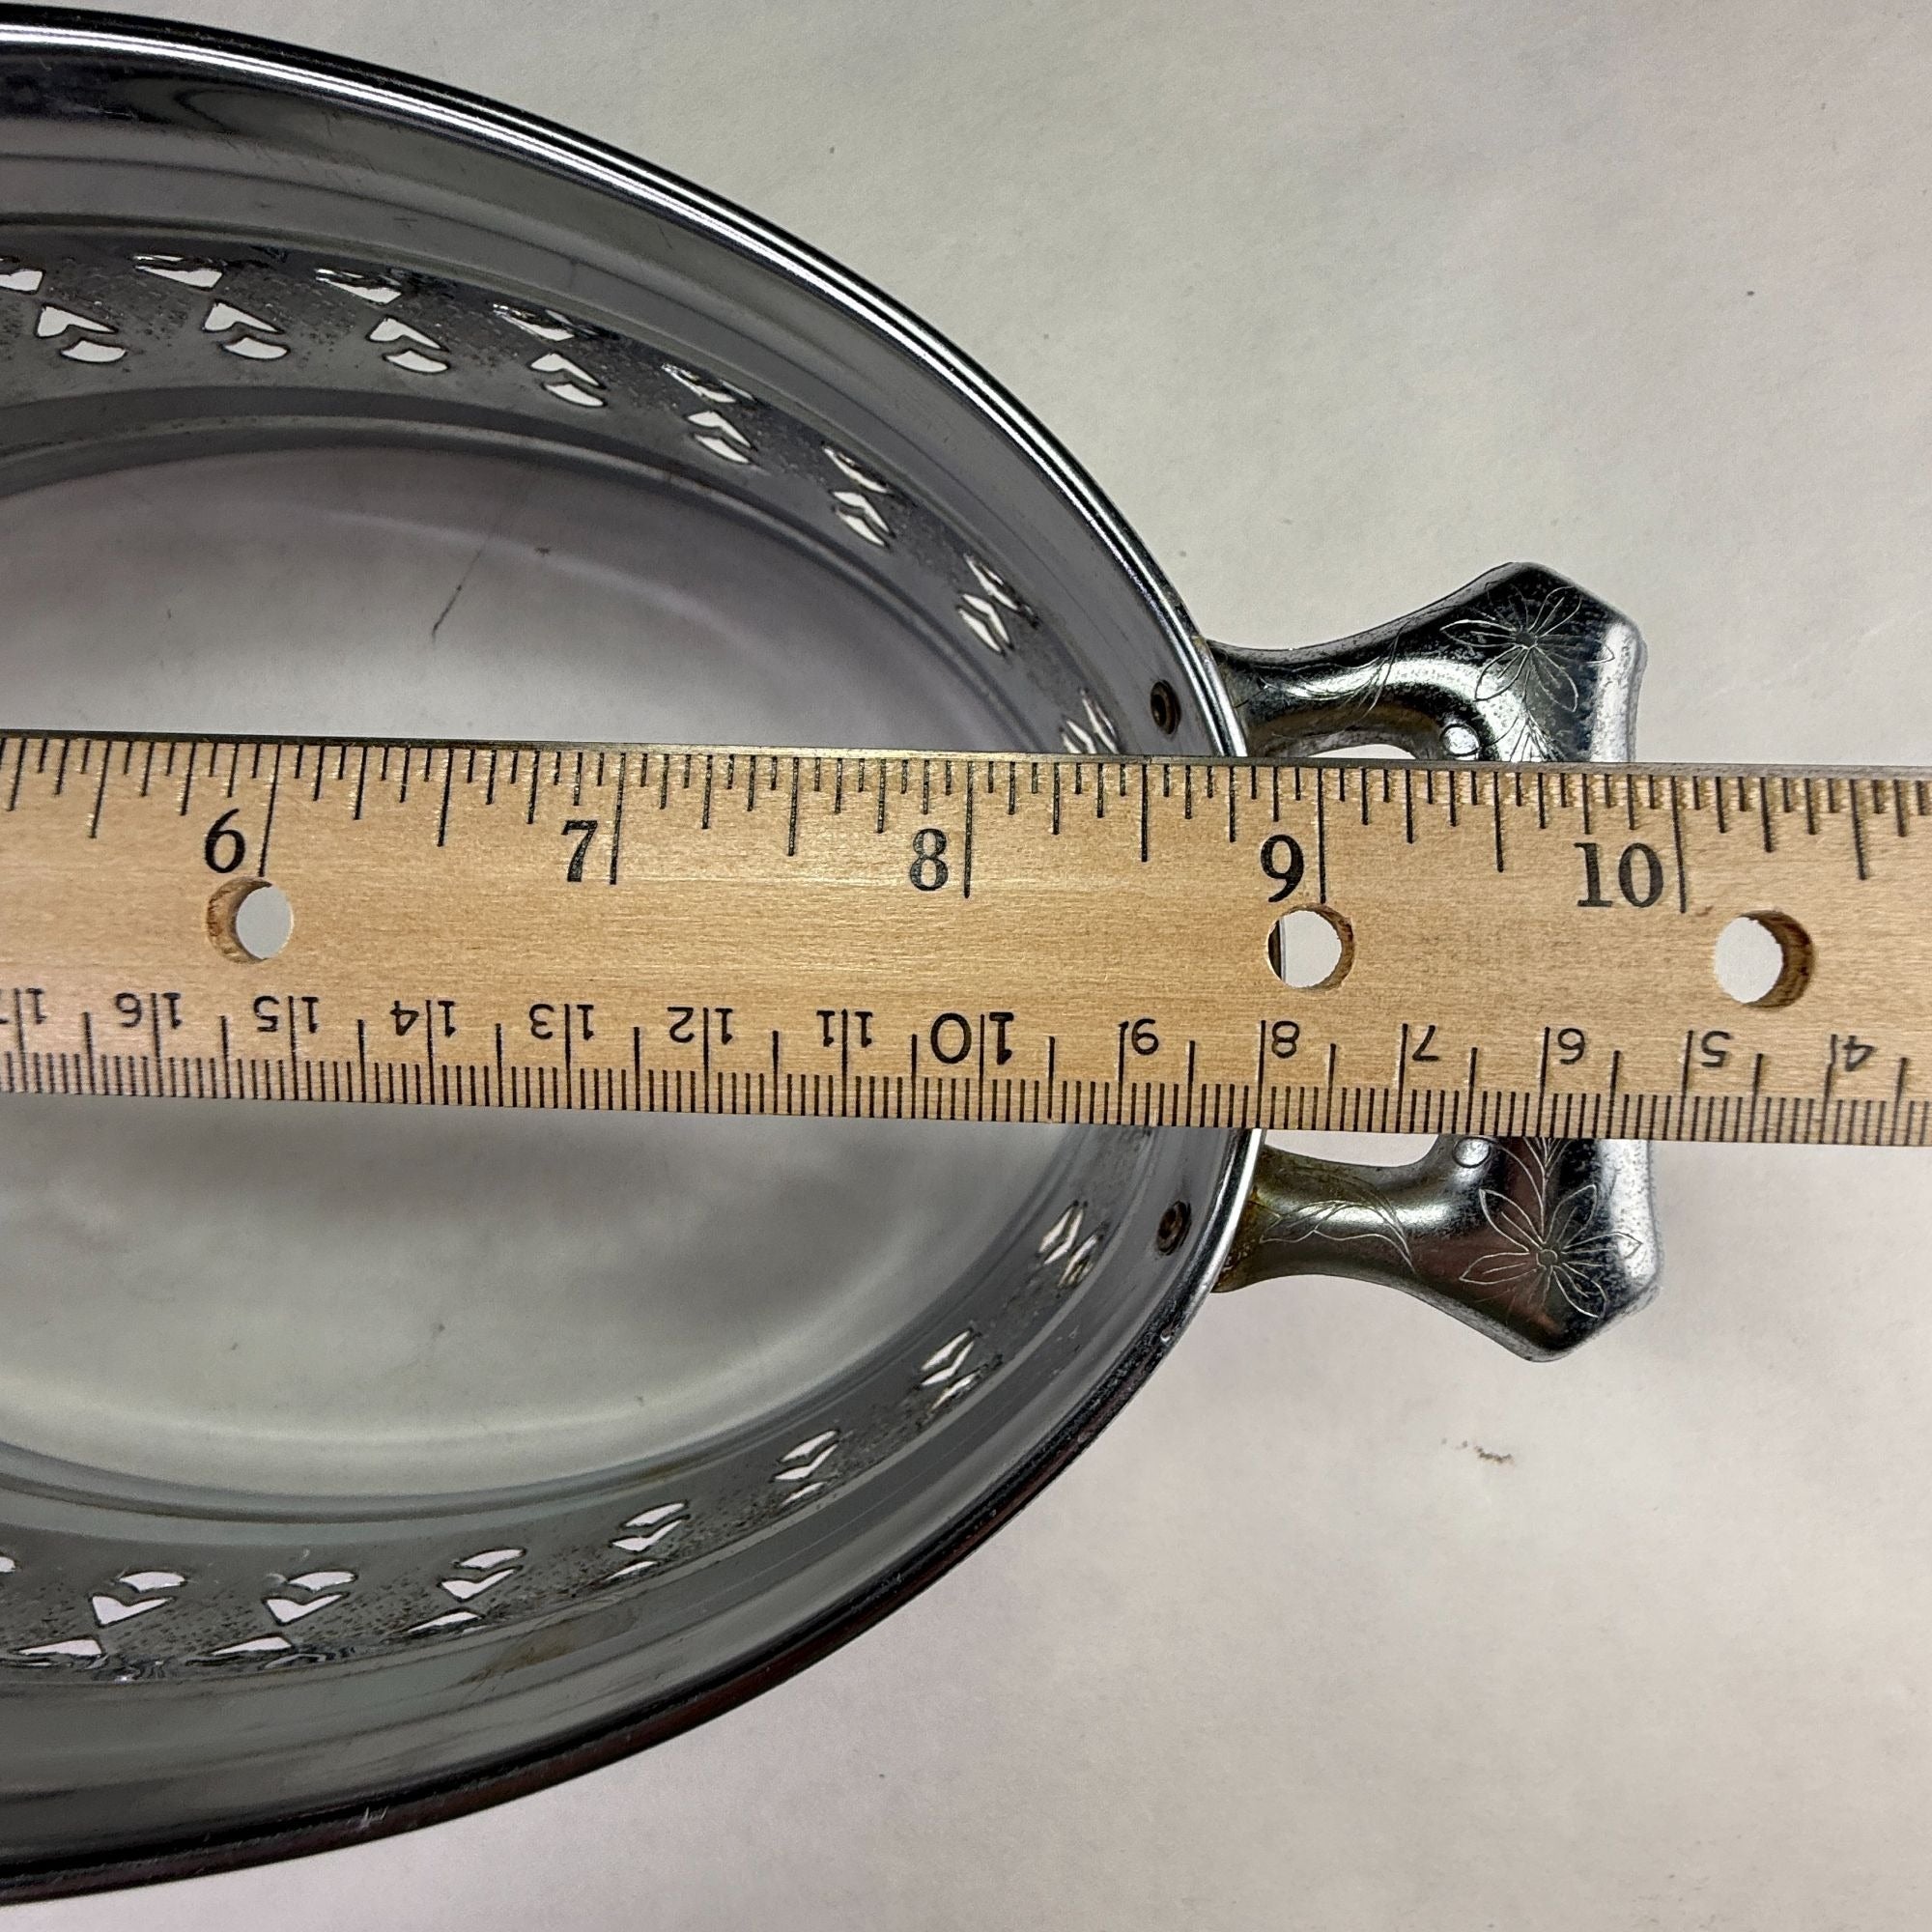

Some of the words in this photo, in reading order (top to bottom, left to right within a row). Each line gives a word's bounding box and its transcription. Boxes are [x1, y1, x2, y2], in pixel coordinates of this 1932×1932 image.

[205, 808, 246, 873] 6
[560, 820, 598, 882] 7
[908, 828, 949, 891] 8
[1260, 834, 1305, 902] 9
[1575, 841, 1664, 908] 10
[114, 991, 182, 1029] 16
[253, 995, 320, 1034] 15
[389, 999, 456, 1037] 14
[528, 1003, 595, 1040] 13
[668, 1007, 734, 1045] 12
[816, 1010, 873, 1048] 11
[930, 1011, 1014, 1065] 10
[1130, 1018, 1159, 1056] 9
[1270, 1020, 1299, 1058] 8
[1412, 1025, 1439, 1062] 7
[1556, 1028, 1586, 1064] 6
[1701, 1030, 1734, 1068] 5
[1843, 1035, 1875, 1072] 4
